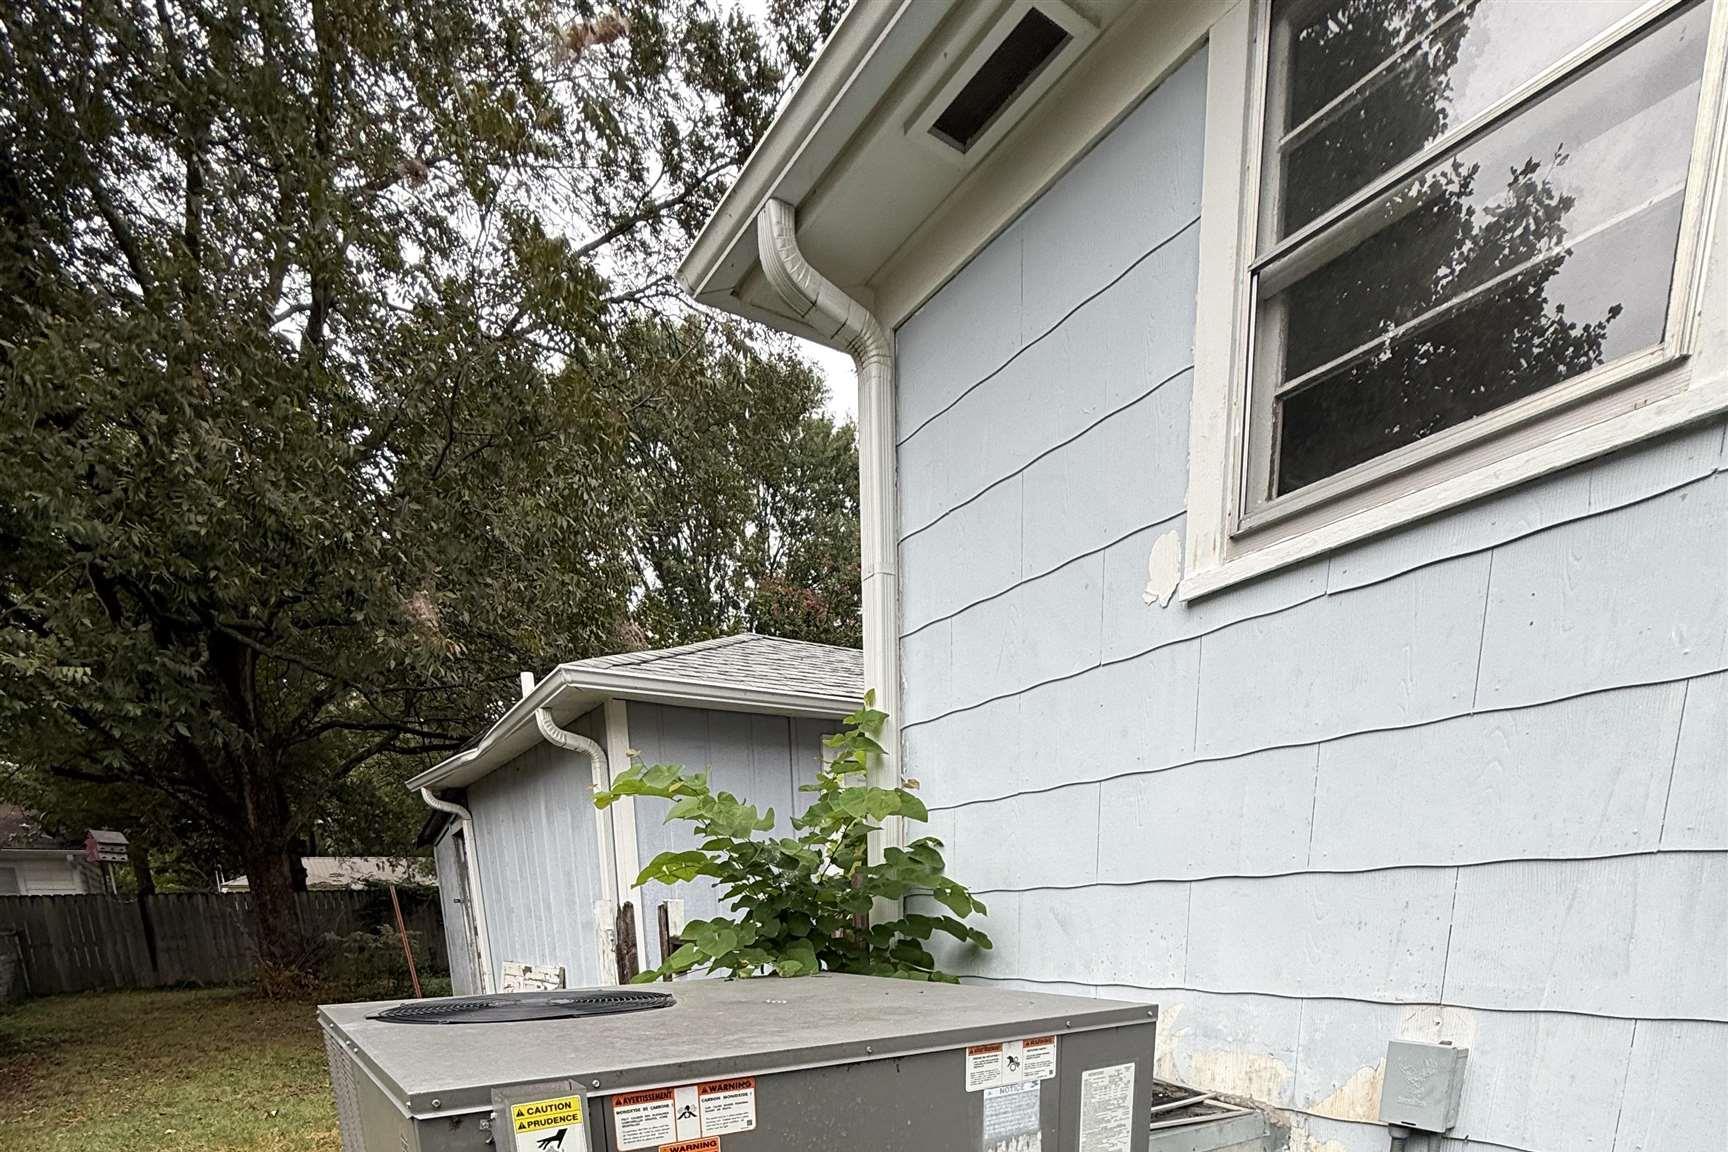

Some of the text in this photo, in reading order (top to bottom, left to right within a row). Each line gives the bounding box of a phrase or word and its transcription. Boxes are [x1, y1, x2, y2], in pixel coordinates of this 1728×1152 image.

[709, 1080, 751, 1093] WARNING
[624, 1091, 672, 1105] AVERTISSEMENT
[527, 1101, 572, 1115] CAUTION
[527, 1114, 578, 1129] PRUDENCE
